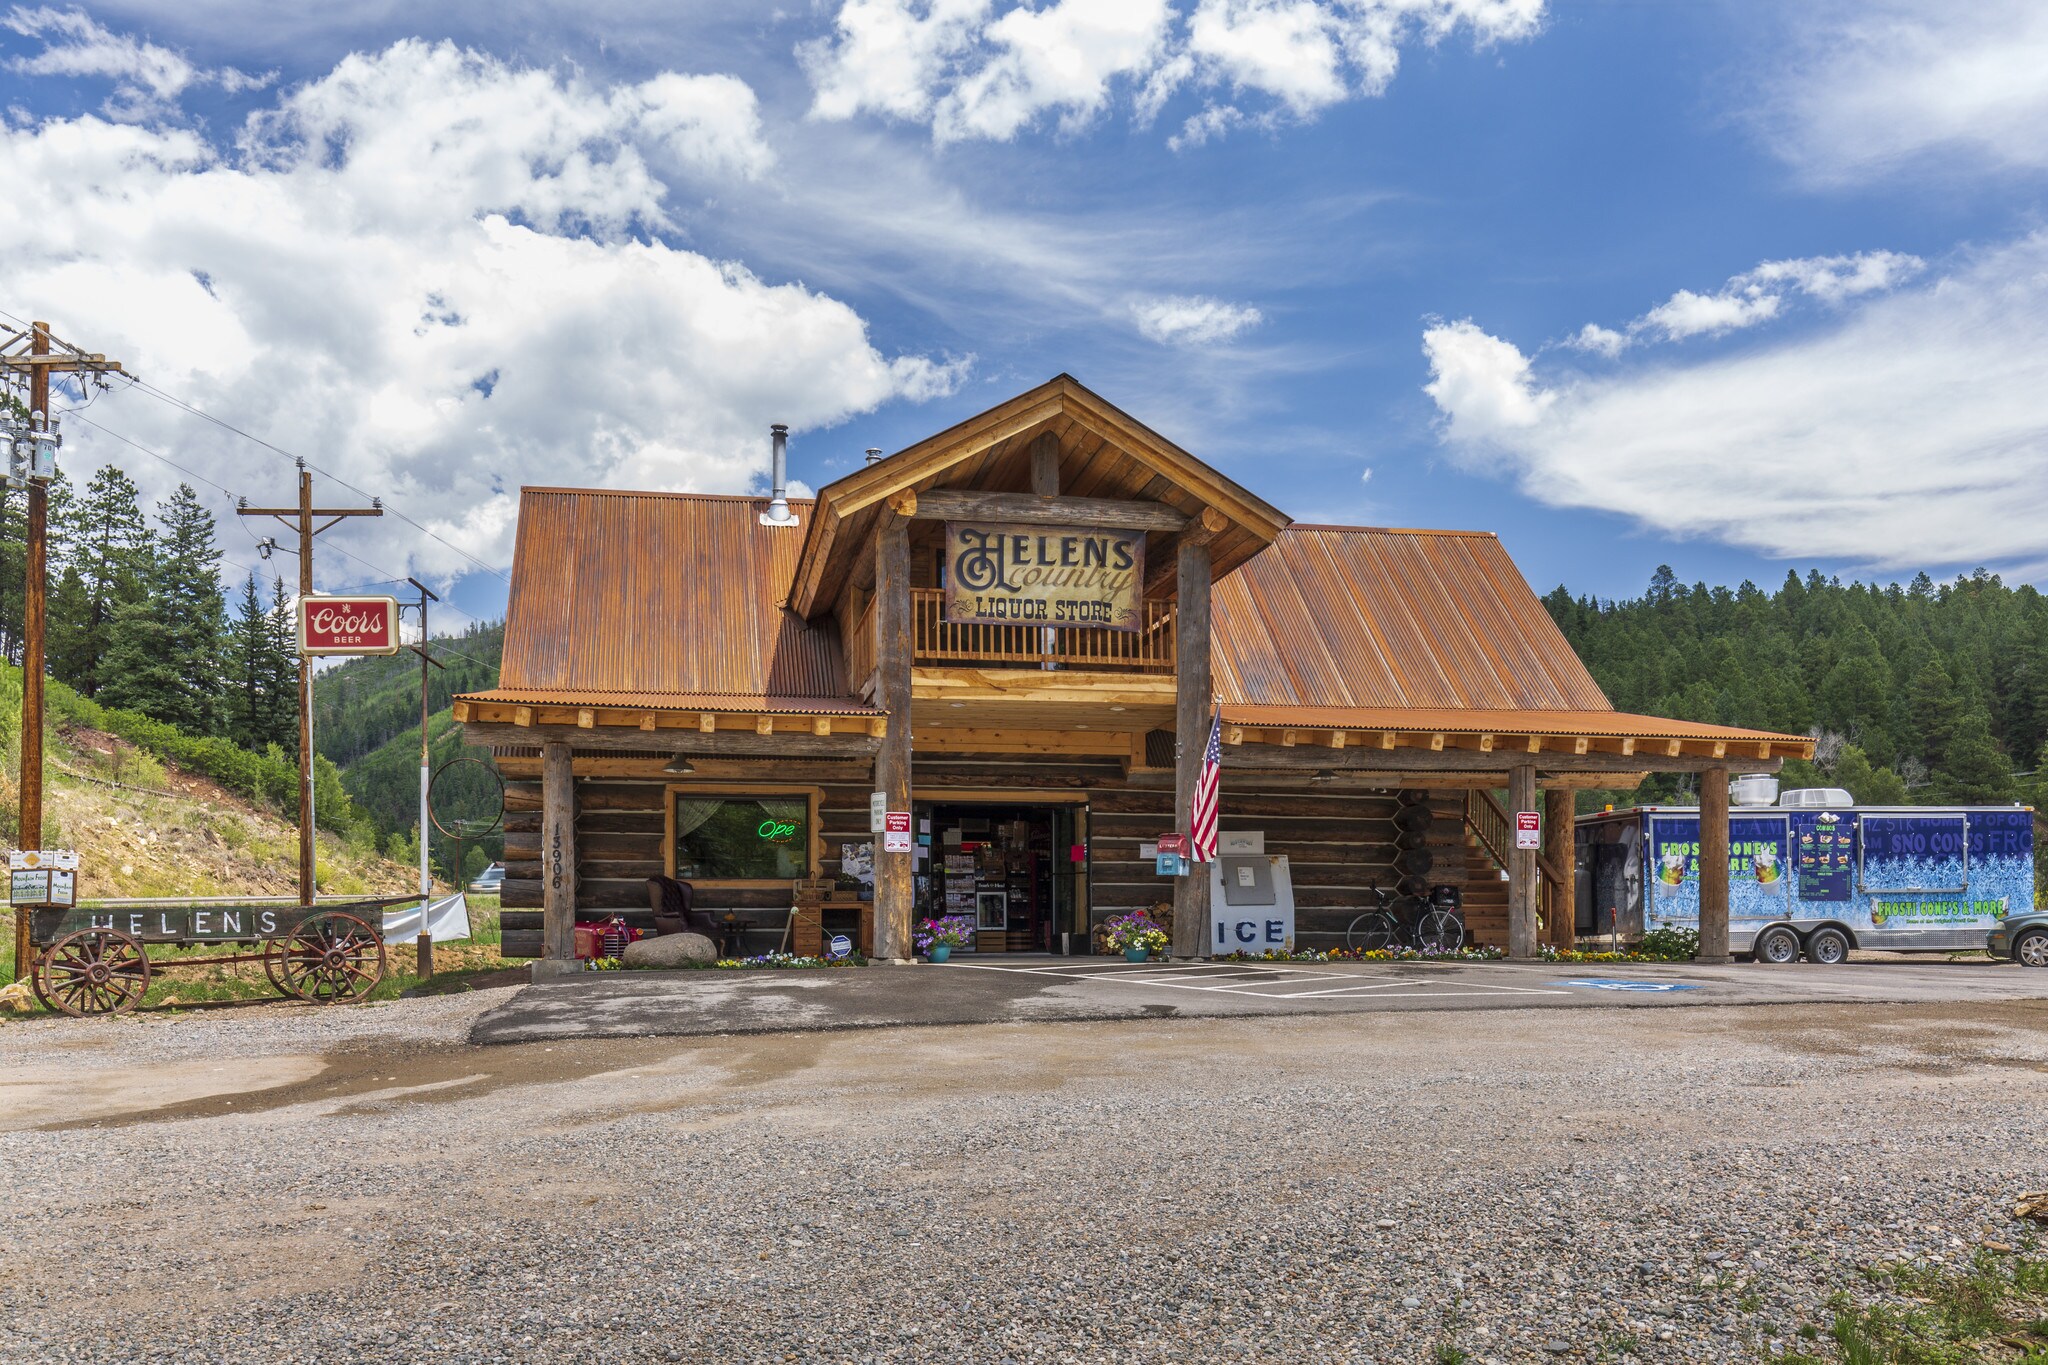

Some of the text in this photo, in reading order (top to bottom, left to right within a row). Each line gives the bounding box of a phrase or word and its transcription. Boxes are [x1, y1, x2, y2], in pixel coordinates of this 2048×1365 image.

[956, 528, 1134, 592] HELENS
[1008, 560, 1133, 602] country
[311, 608, 383, 634] Coors
[976, 597, 1113, 622] LIQUOR STORE
[334, 636, 361, 644] BEER
[758, 820, 795, 839] Ope
[552, 822, 562, 889] 13906
[1661, 842, 1778, 856] FROS ONE'S
[1891, 833, 1926, 853] SNO
[1690, 858, 1749, 871] & RE
[1878, 900, 2004, 916] FROSTI CONE'S & MORE
[91, 911, 276, 937] HELENS
[1218, 918, 1284, 943] ICE
